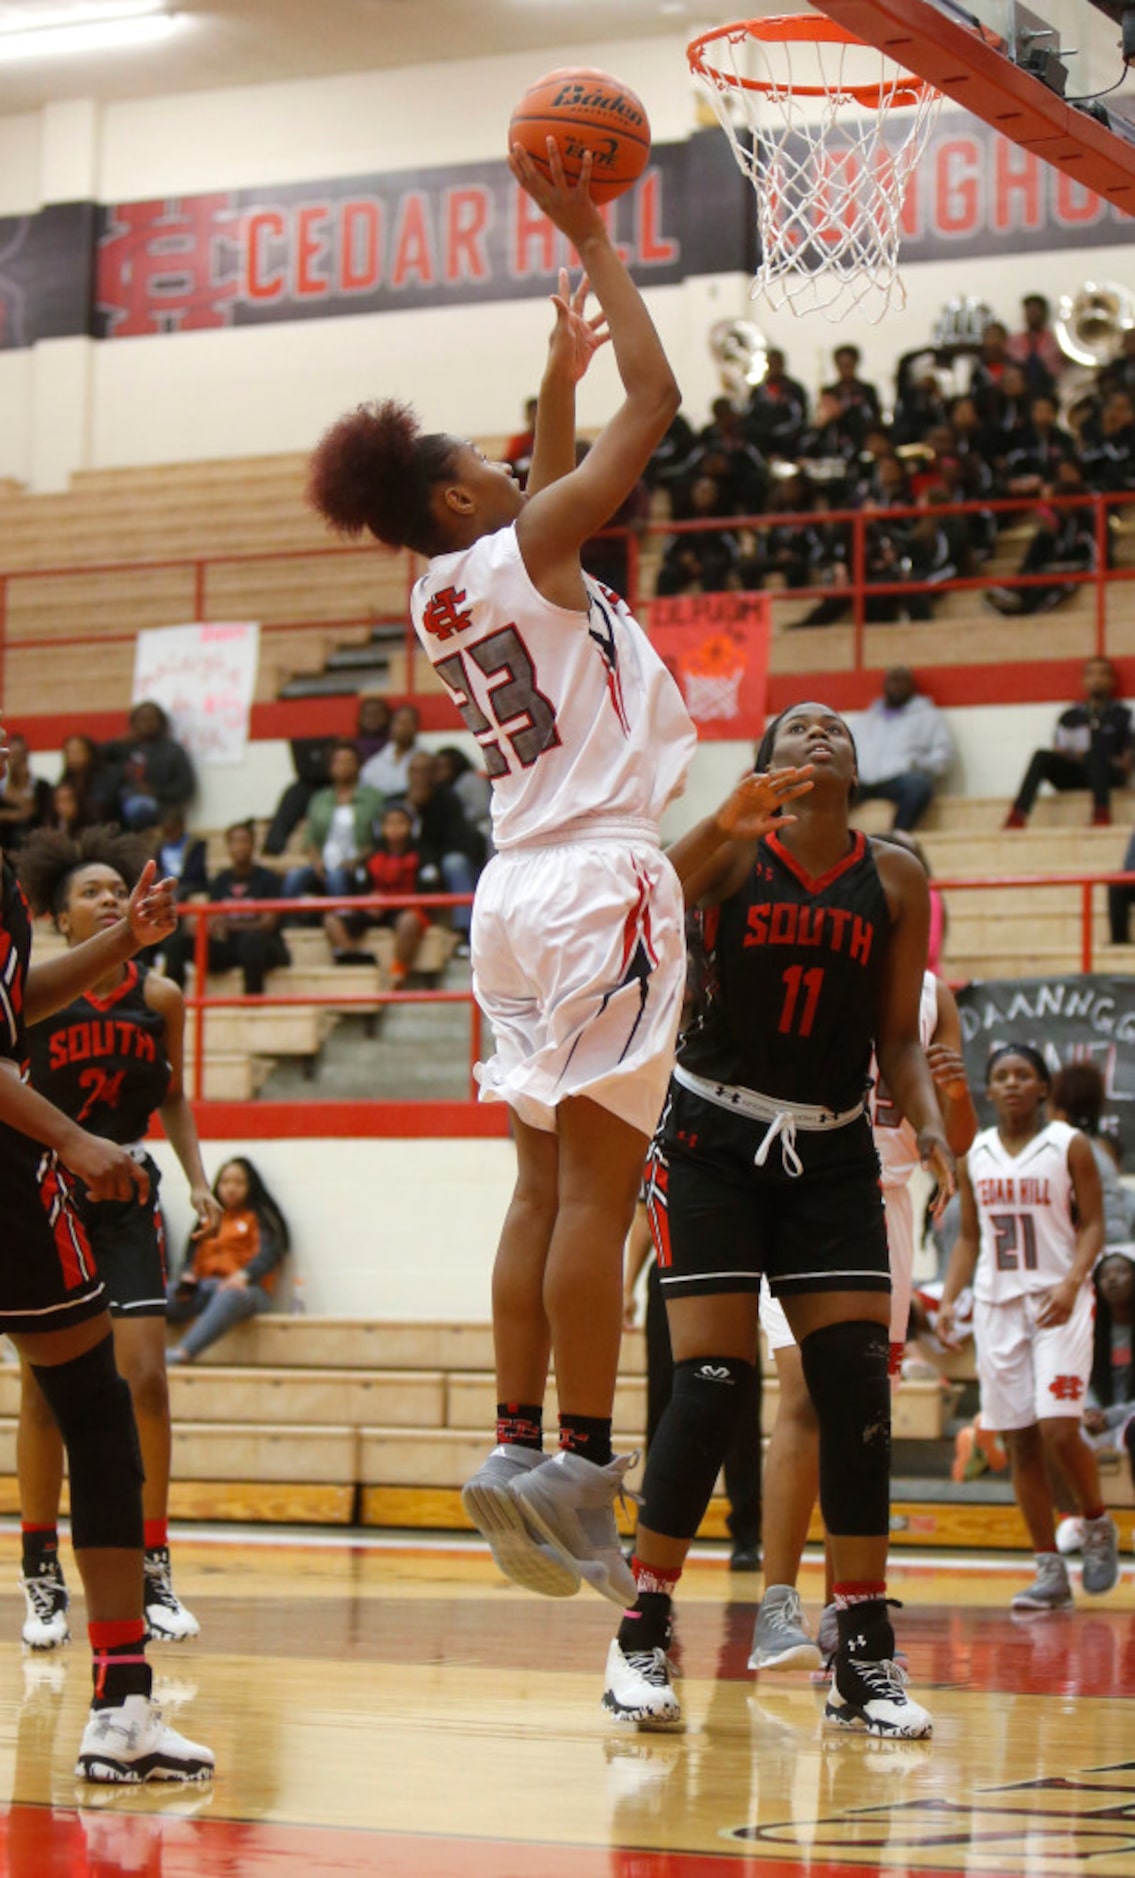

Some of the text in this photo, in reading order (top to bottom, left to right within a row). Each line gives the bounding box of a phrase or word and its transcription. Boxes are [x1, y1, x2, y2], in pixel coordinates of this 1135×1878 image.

[552, 85, 643, 126] Baden
[245, 186, 490, 300] CEDAR
[433, 621, 563, 780] 23
[742, 901, 874, 967] SOUTH
[778, 963, 825, 1038] 11
[49, 1020, 156, 1072] SOUTH
[1019, 1178, 1051, 1206] HILL
[988, 1212, 1038, 1272] 21
